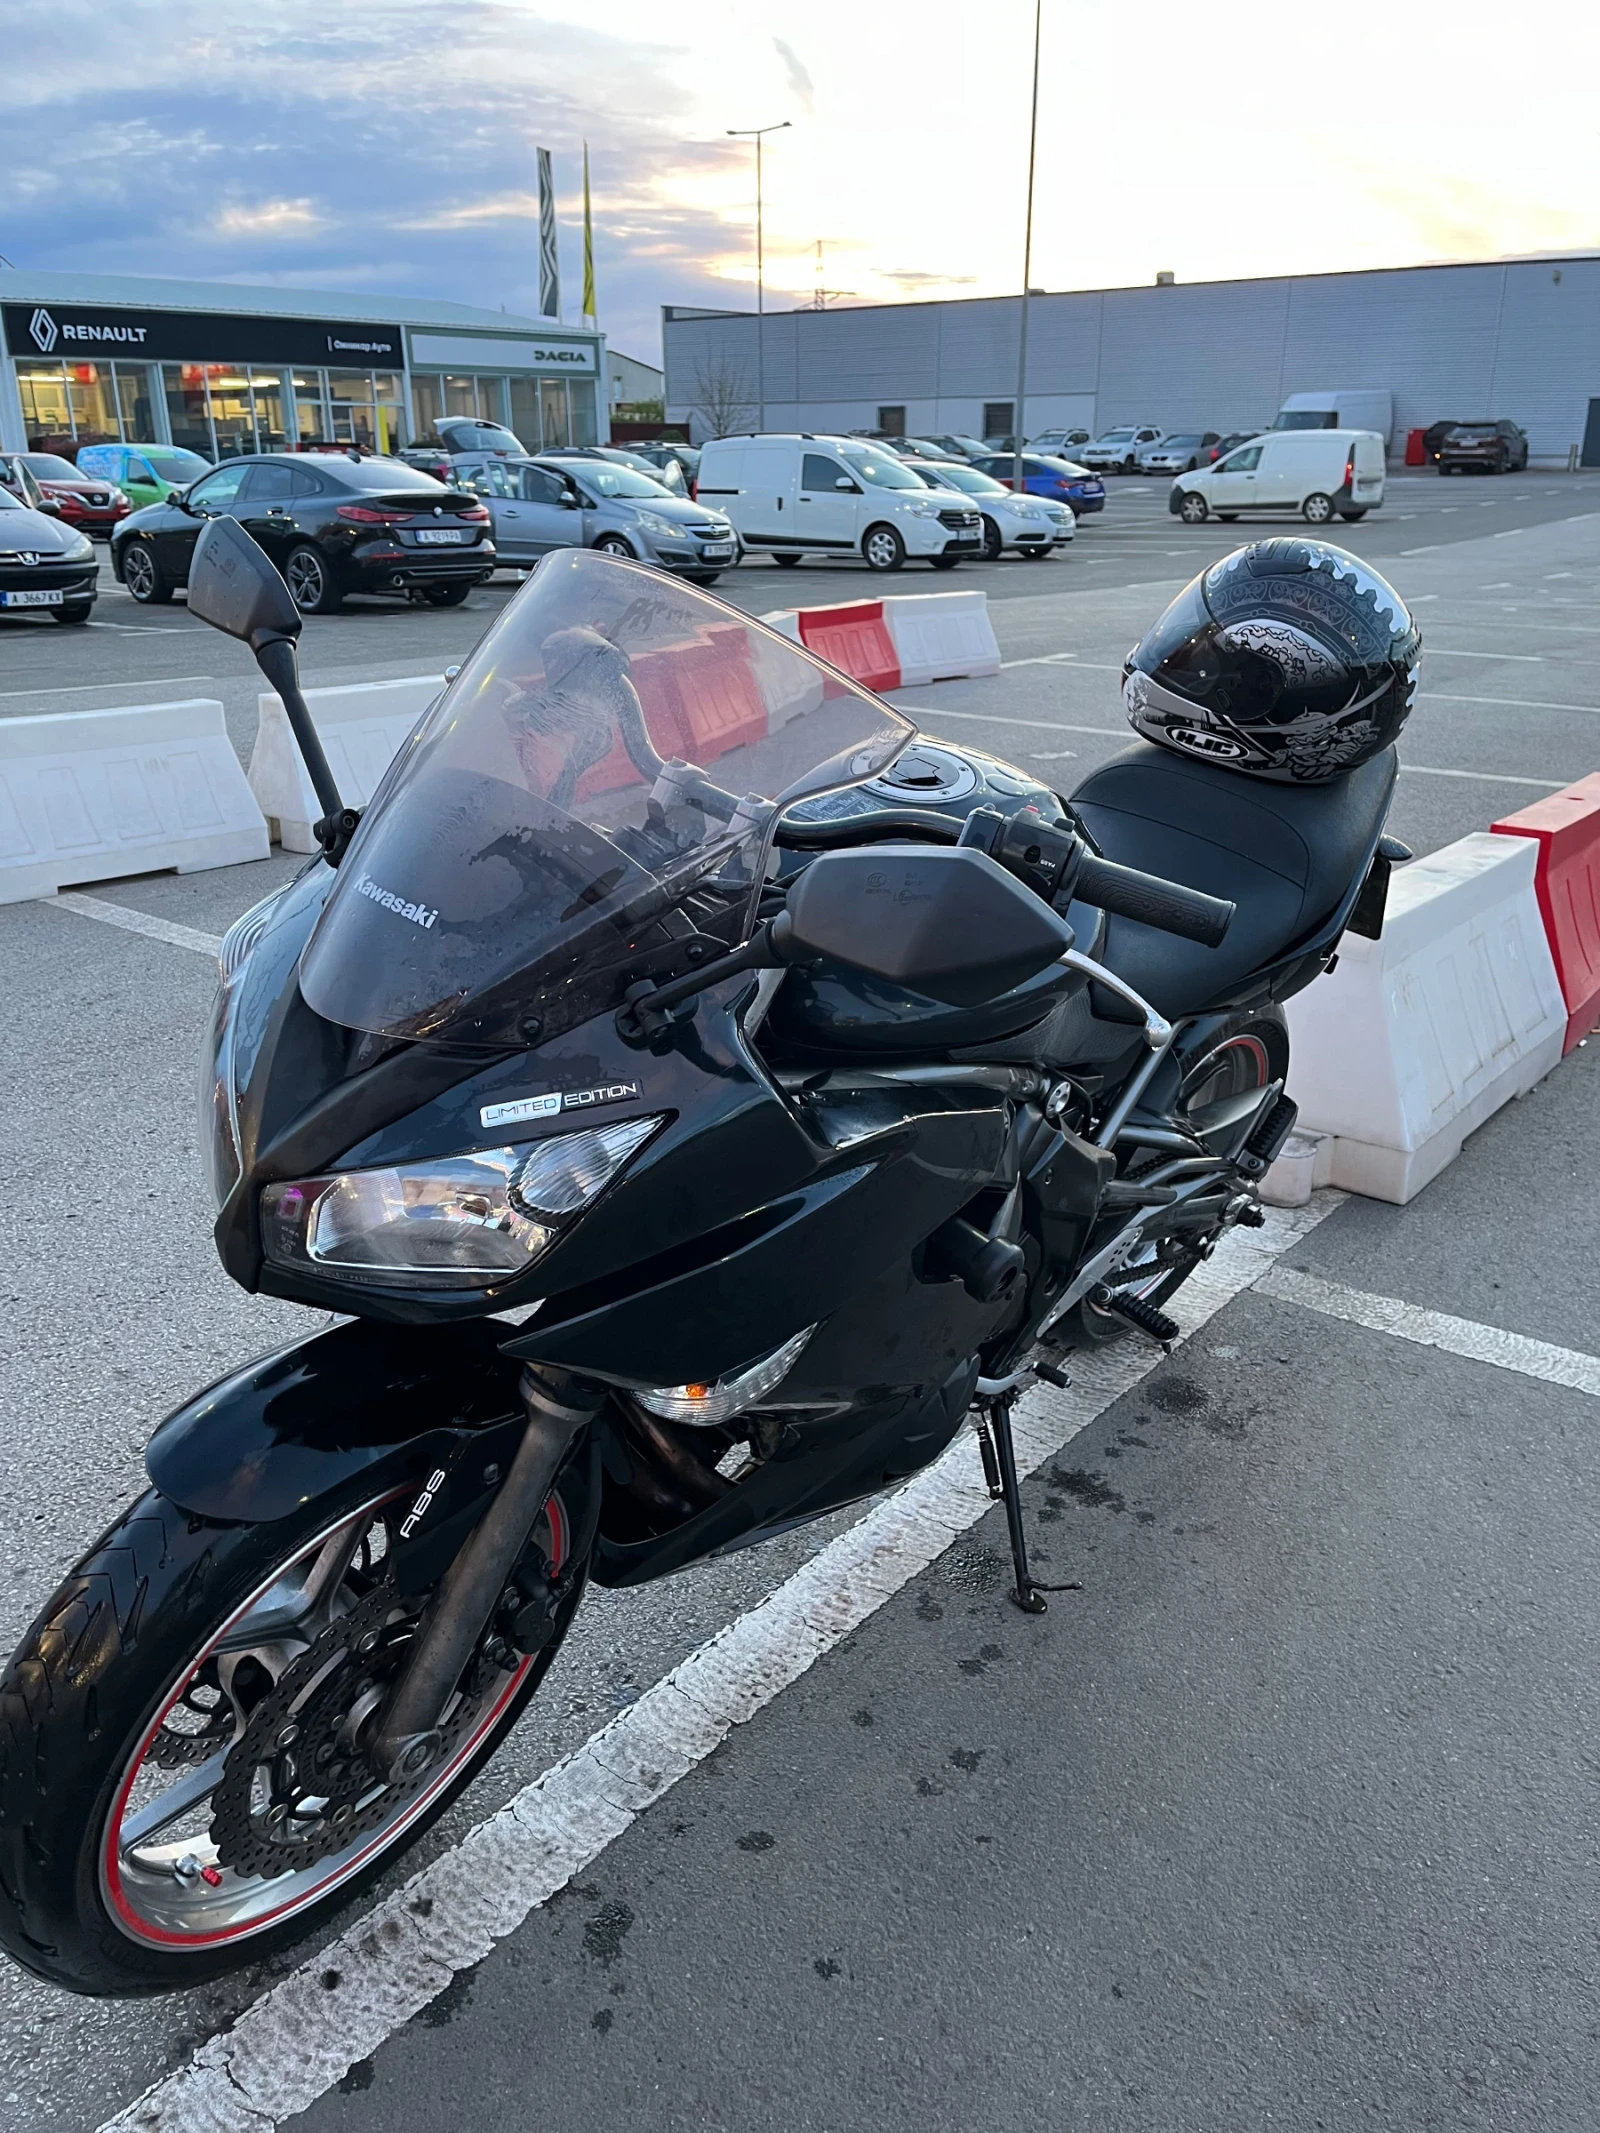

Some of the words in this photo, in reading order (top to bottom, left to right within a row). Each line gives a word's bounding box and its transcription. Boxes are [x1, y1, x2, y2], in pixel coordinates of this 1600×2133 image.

[62, 324, 147, 342] RENAULT
[533, 350, 587, 362] DACIA
[12, 594, 19, 604] A
[1175, 729, 1235, 755] HJC
[353, 872, 439, 929] Kawasaki
[486, 1097, 557, 1121] LIMITED
[564, 1082, 638, 1107] EDITION
[399, 1468, 446, 1539] ABS
